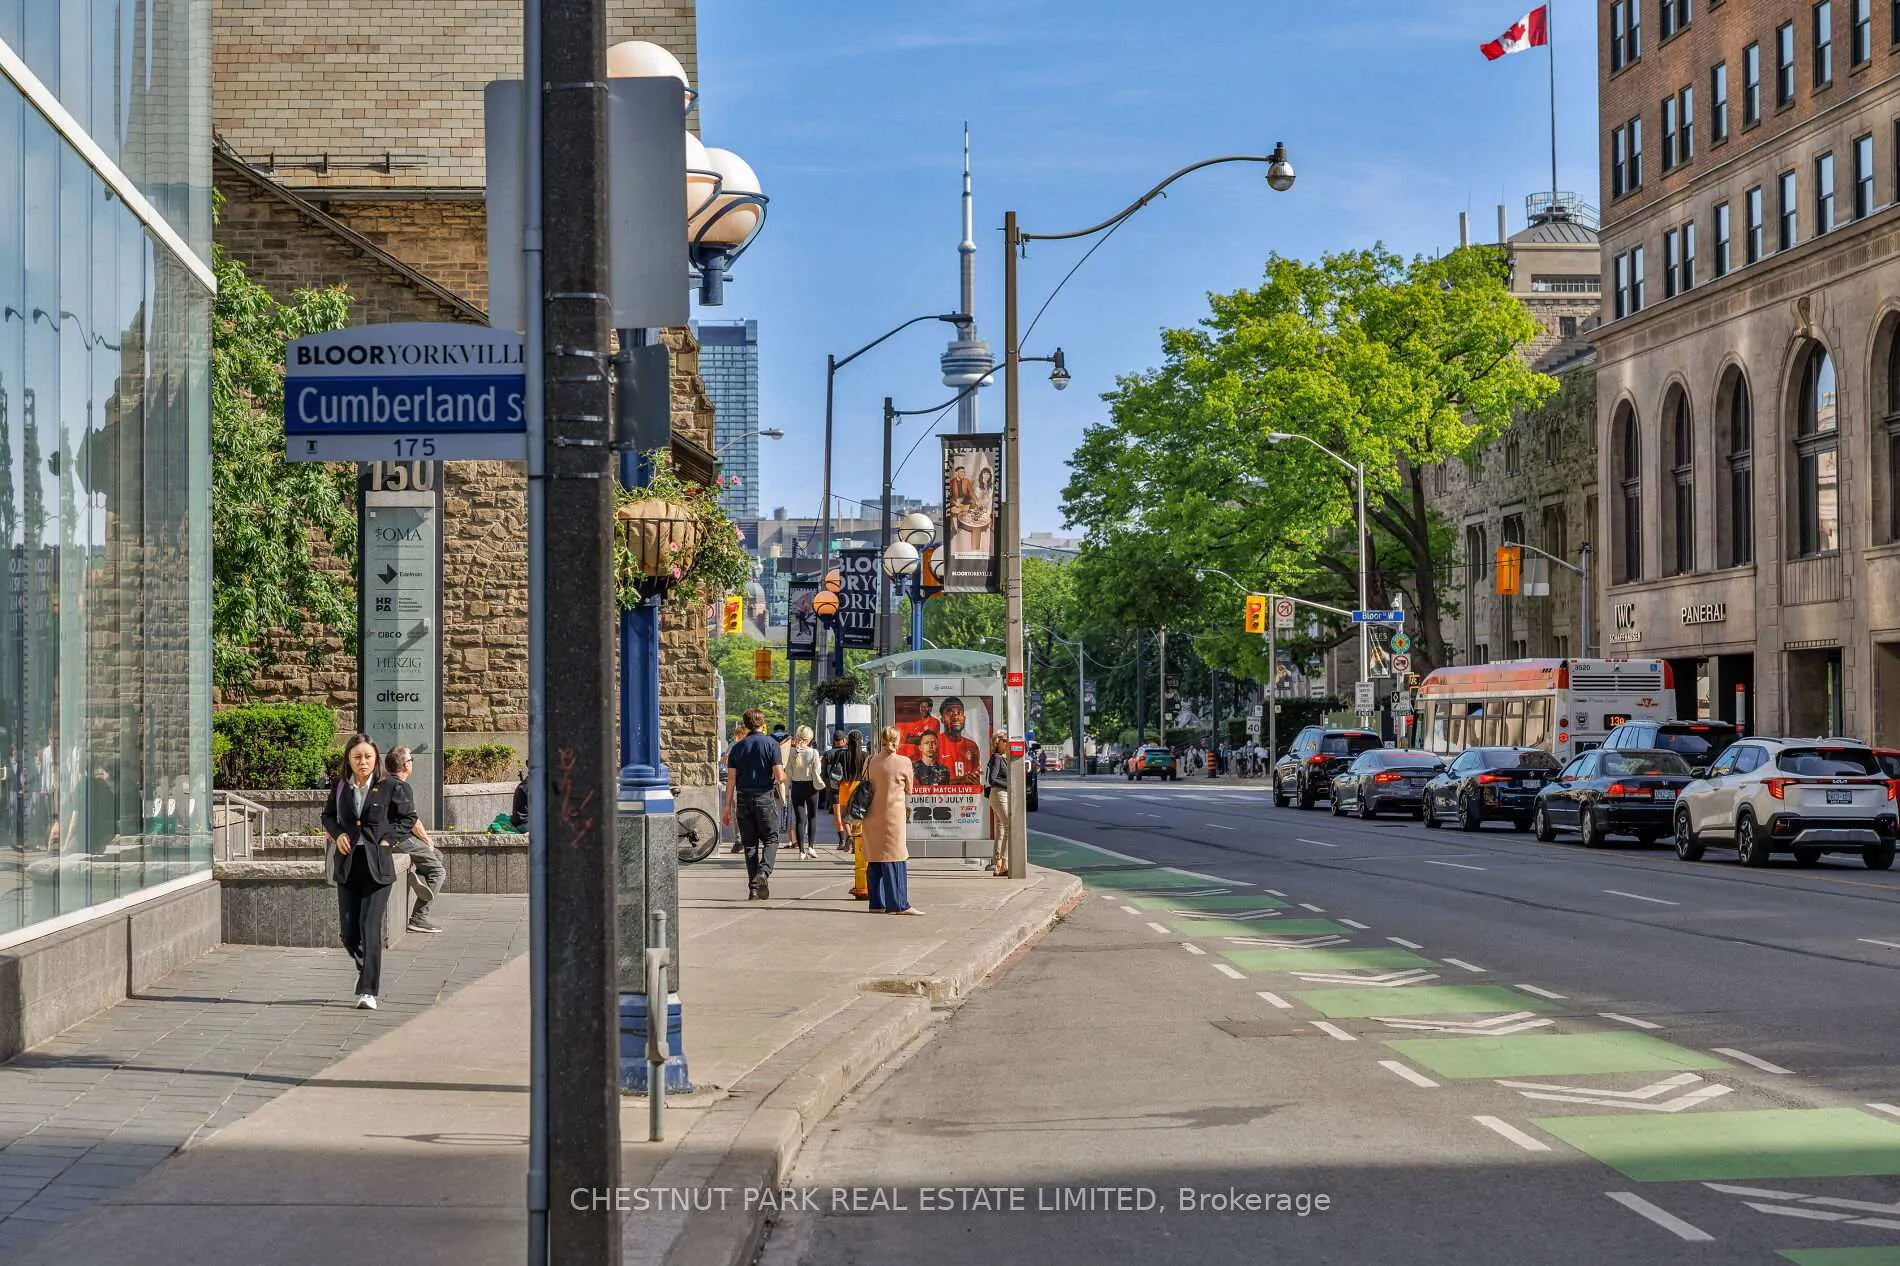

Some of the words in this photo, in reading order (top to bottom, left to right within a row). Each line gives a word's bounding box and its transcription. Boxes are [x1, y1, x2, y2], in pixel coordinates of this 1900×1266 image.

[299, 385, 496, 424] Cumberland
[507, 393, 525, 422] S
[393, 438, 436, 457] 175
[367, 460, 434, 491] 150
[1362, 612, 1382, 620] Bloor
[1388, 612, 1394, 620] W
[1615, 603, 1634, 628] IWC
[1682, 602, 1725, 624] PANERAI
[377, 631, 395, 639] CIBC
[377, 656, 422, 668] HERZIG
[376, 689, 419, 702] altera
[372, 722, 424, 730] CYMBRIA
[1248, 723, 1260, 733] 40
[955, 761, 964, 776] 19
[910, 796, 929, 804] JUNE
[931, 796, 937, 804] 11
[945, 796, 964, 804] JULY
[966, 796, 974, 804] 19
